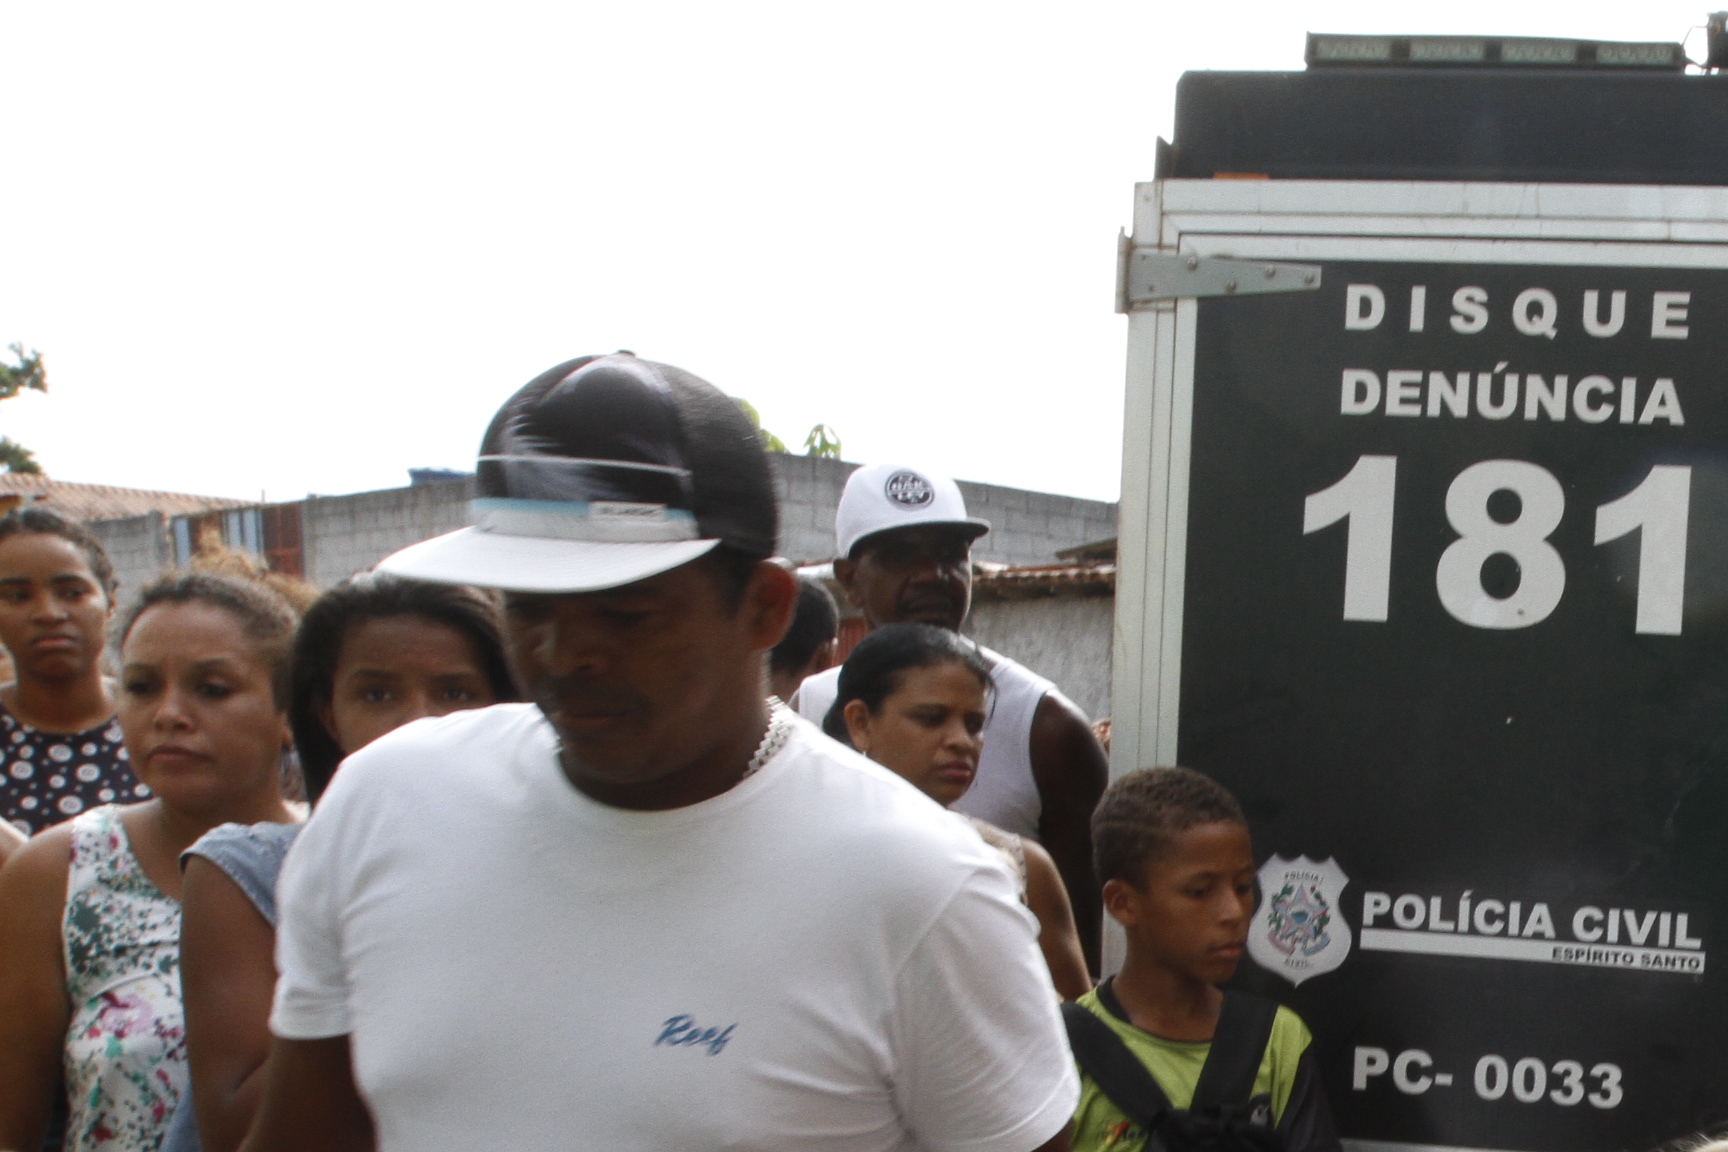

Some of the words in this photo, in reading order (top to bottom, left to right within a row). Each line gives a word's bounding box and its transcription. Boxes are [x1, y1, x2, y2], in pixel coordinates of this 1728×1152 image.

[1345, 283, 1691, 340] DISQUE
[1340, 361, 1685, 426] DENÚNCIA
[1303, 454, 1692, 636] 181
[1362, 889, 1556, 940] POLÍCIA
[1572, 906, 1702, 949] CIVIL
[1552, 944, 1635, 966] ESPÍRITO
[1640, 952, 1701, 971] SANTO
[652, 1013, 739, 1056] Reef
[1353, 1046, 1453, 1095] PC-
[1474, 1054, 1624, 1110] 0033
